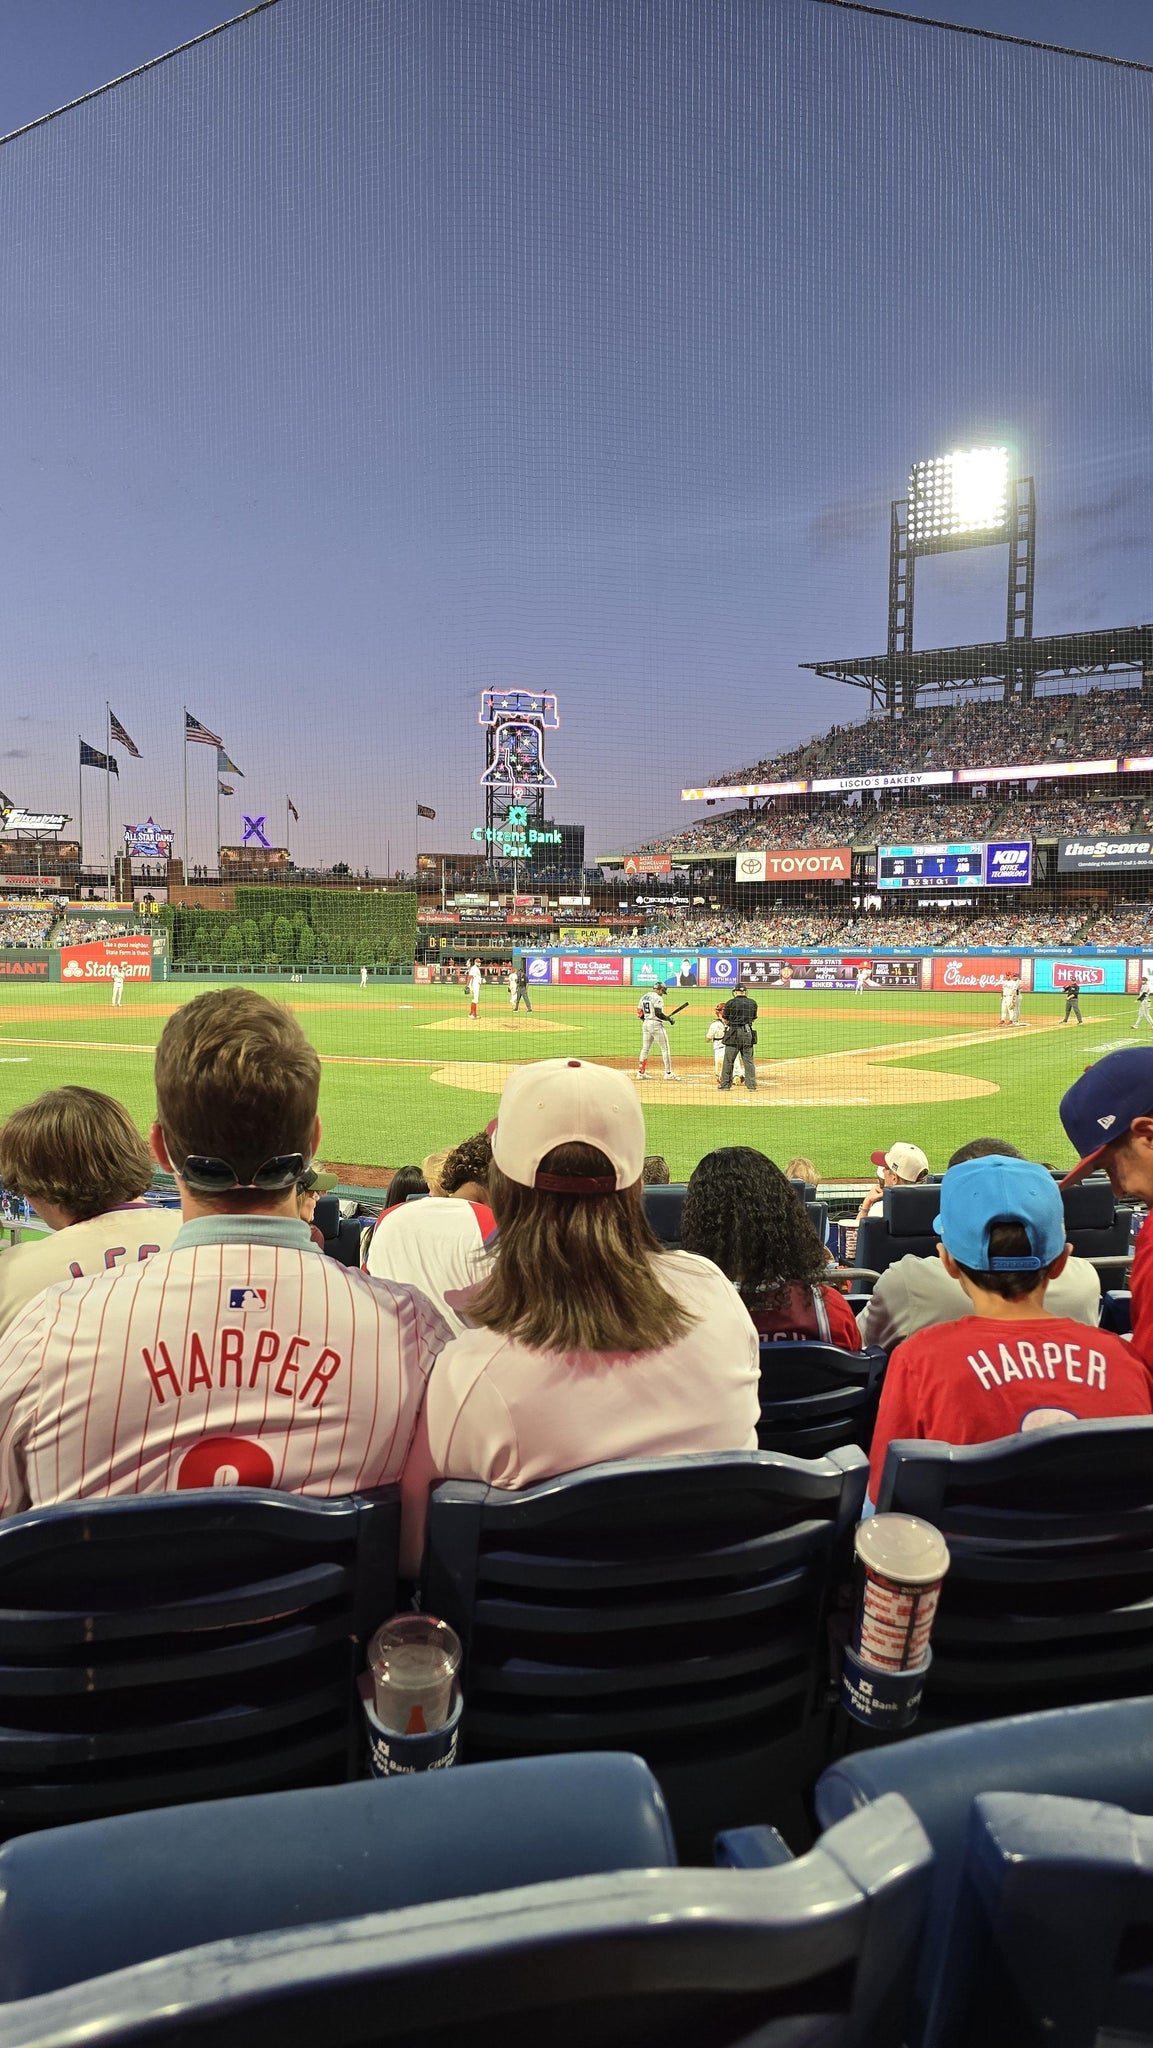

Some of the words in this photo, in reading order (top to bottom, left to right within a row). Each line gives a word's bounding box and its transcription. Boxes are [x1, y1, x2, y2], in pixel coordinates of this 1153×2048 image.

[840, 778, 879, 788] LISCIO'S
[884, 776, 922, 785] BAKERY
[138, 832, 155, 842] STAR
[155, 832, 174, 842] GAME
[529, 829, 562, 844] Bank
[502, 843, 532, 858] Park
[1064, 841, 1150, 856] theScore
[992, 850, 1028, 864] KDI
[770, 856, 845, 873] TOYOTA
[991, 870, 1027, 878] TECHNOLOGY
[589, 961, 611, 969] Chase
[597, 968, 619, 976] Center
[290, 974, 303, 983] 401
[1057, 968, 1098, 982] HERR'S
[141, 1327, 342, 1408] HARPER
[967, 1340, 1106, 1391] HARPER
[851, 1695, 872, 1715] Park
[872, 1698, 898, 1711] Bank
[389, 1759, 416, 1773] Bank
